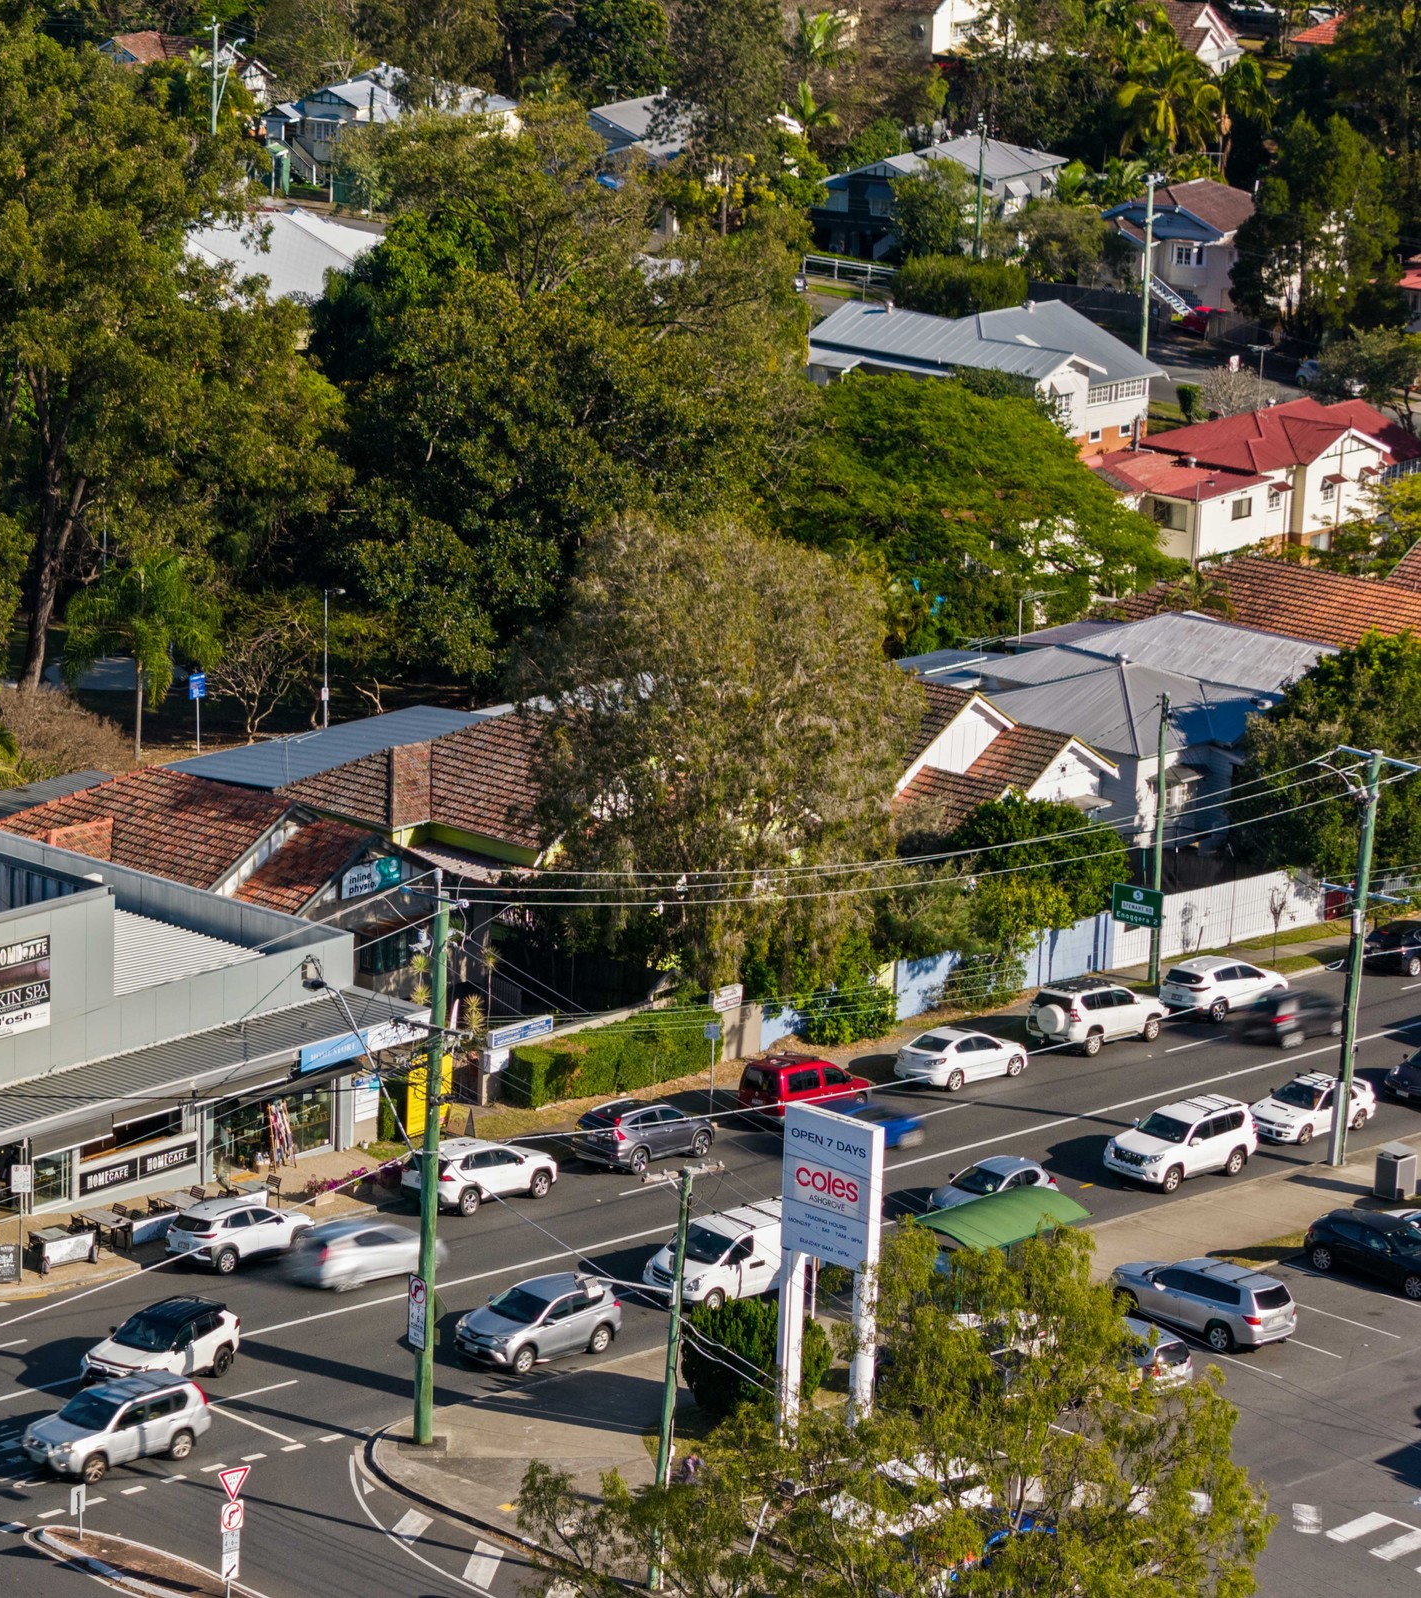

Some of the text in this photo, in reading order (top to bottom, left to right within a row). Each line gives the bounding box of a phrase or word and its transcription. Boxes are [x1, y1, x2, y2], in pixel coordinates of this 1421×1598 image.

[350, 873, 371, 884] inline
[1116, 911, 1150, 923] Enoggera
[25, 983, 48, 1000] SPA
[791, 1128, 866, 1158] OPEN 7 DAYS
[796, 1167, 858, 1203] coles
[809, 1195, 845, 1212] ASHGROVE
[788, 1217, 811, 1228] MONDAY
[805, 1213, 847, 1231] TRADING HOURS
[800, 1237, 820, 1247] SUNDAY
[227, 1473, 240, 1481] GIVE
